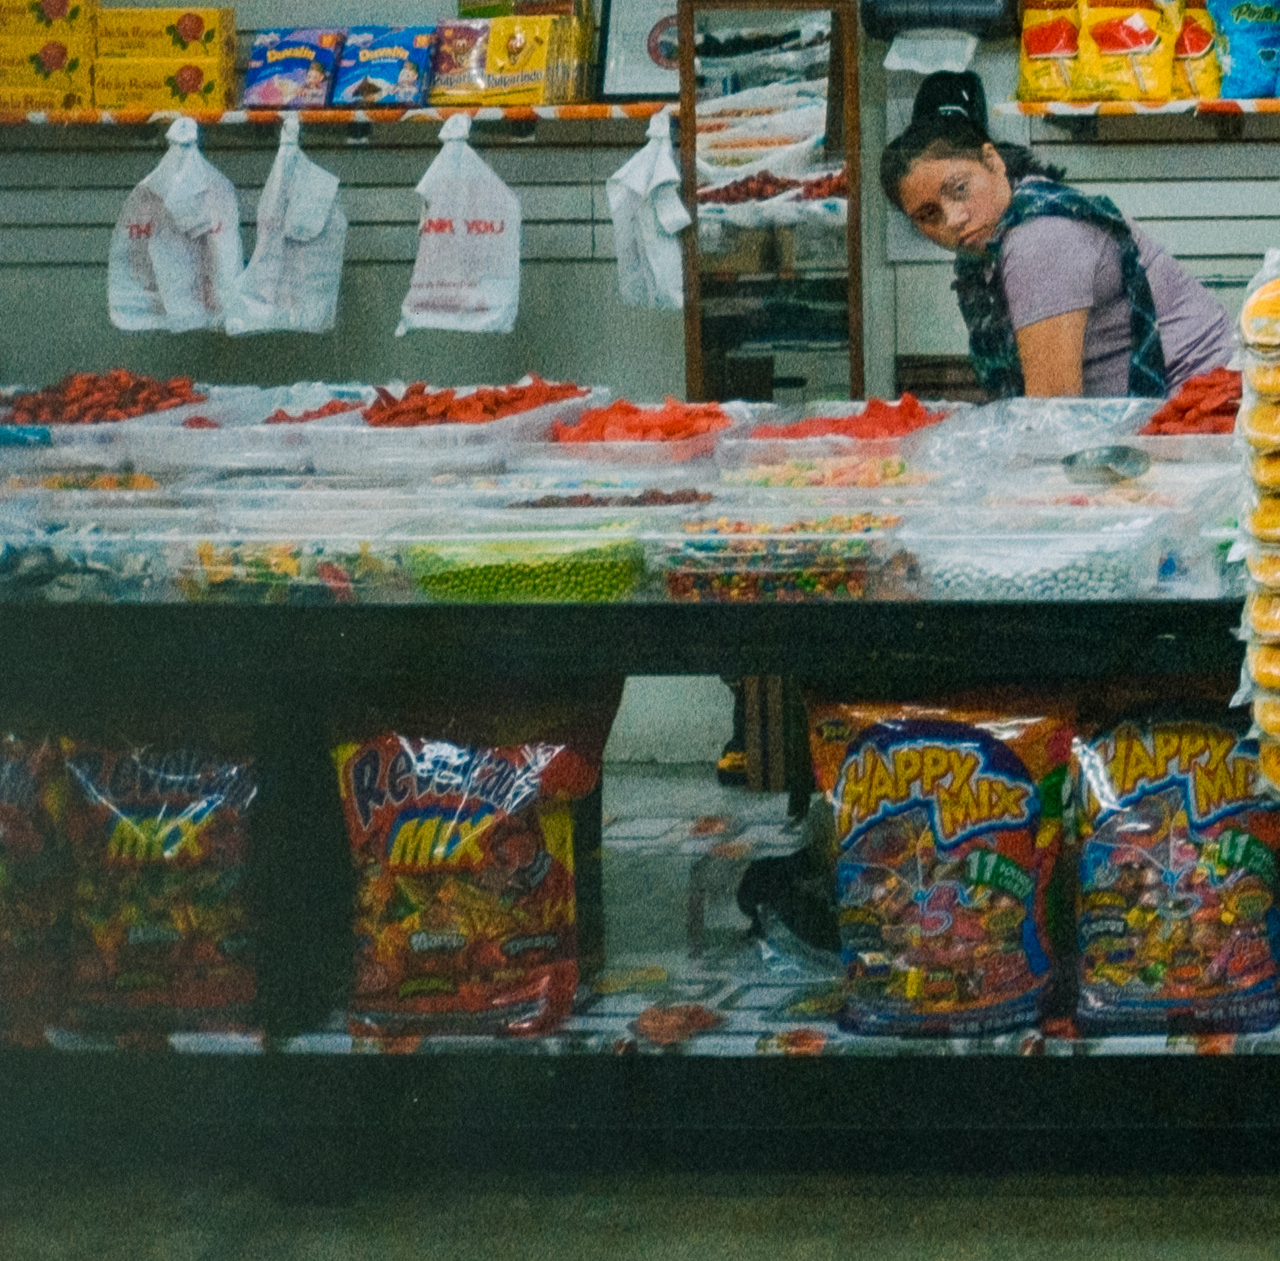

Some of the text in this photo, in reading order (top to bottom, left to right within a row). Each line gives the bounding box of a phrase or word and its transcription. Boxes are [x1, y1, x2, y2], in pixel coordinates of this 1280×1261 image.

[464, 219, 506, 235] YOU
[841, 746, 977, 837] HAPPY
[937, 780, 1028, 837] MIX
[1195, 758, 1257, 817] MI
[388, 814, 498, 866] MIX
[966, 850, 998, 882] 11
[1221, 834, 1249, 863] 11
